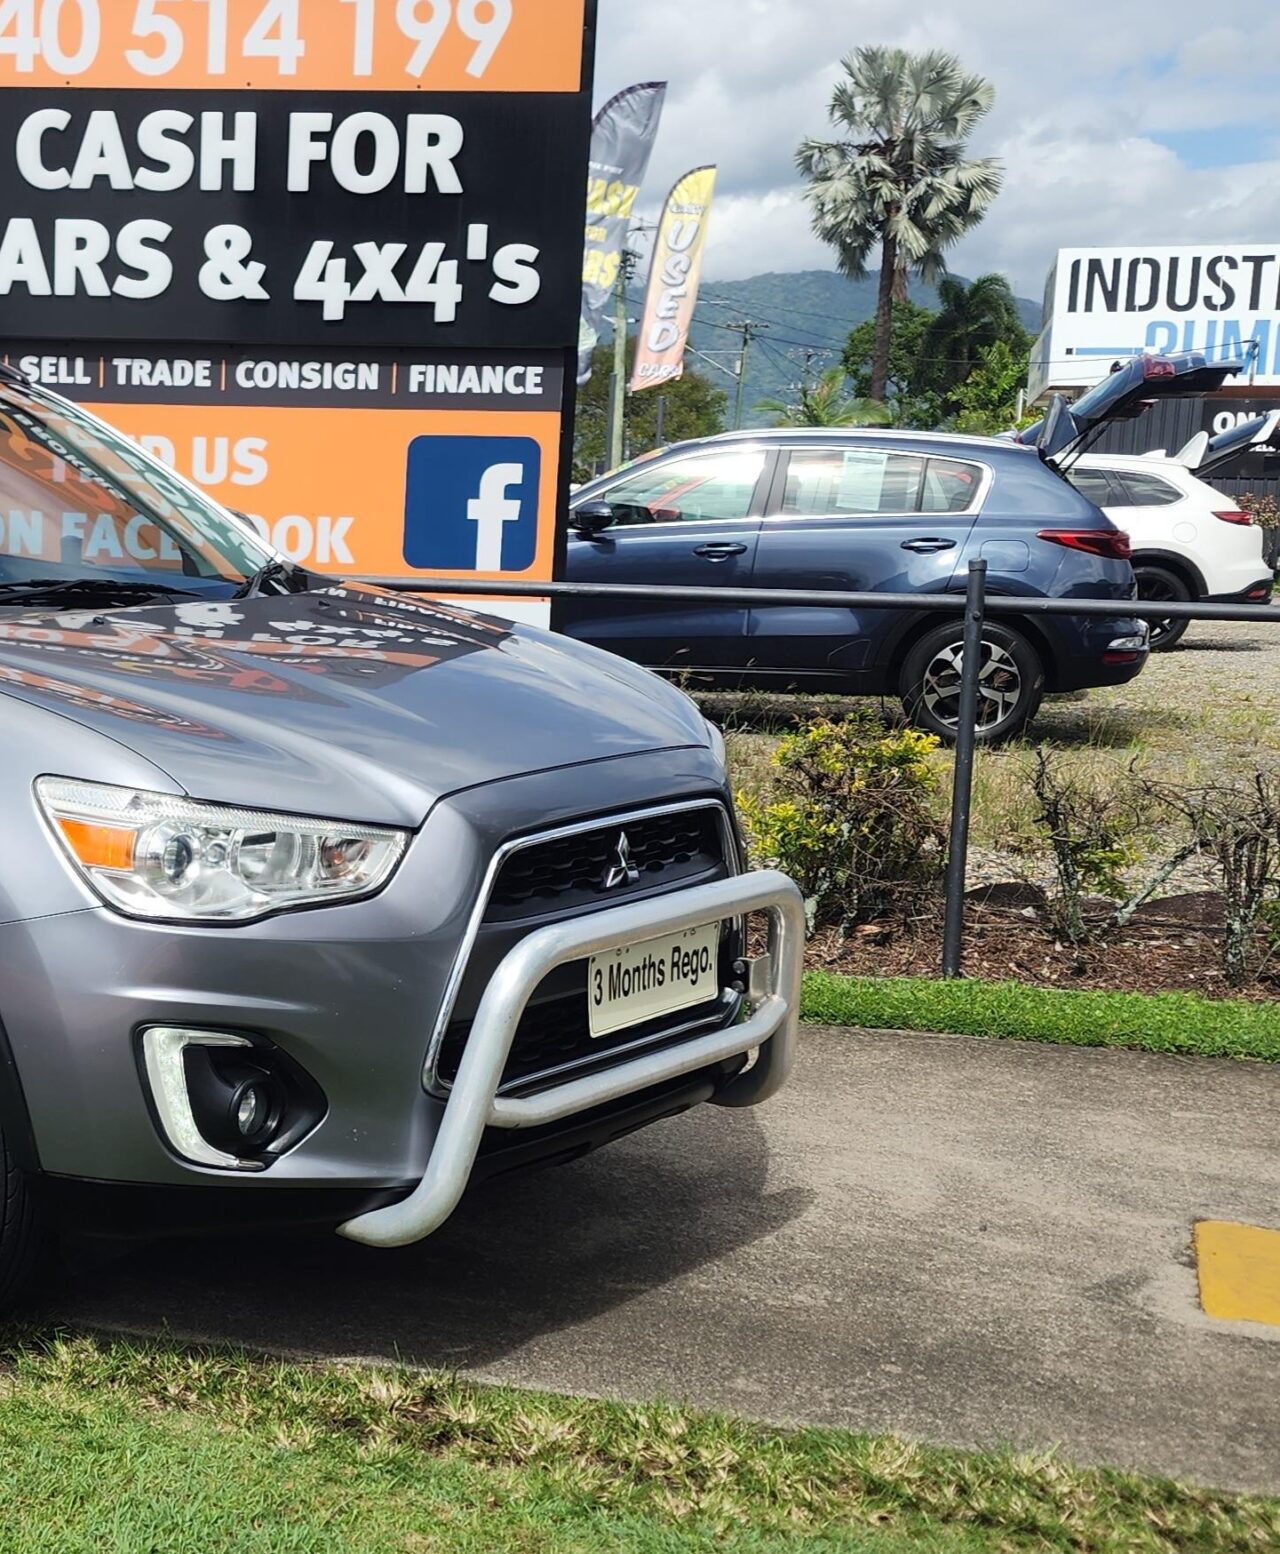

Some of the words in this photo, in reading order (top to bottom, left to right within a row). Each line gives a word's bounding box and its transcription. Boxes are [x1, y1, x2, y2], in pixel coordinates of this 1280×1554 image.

[124, 0, 306, 76] 514
[340, 0, 513, 79] 199
[15, 107, 257, 192] CASH
[287, 111, 464, 194] FOR
[198, 223, 270, 300] &
[647, 219, 700, 353] USED
[1067, 255, 1280, 313] INDUST
[20, 355, 91, 385] SELL
[113, 358, 211, 388] TRADE
[235, 361, 380, 392] CONSIGN
[408, 364, 544, 395] FINANCE
[1144, 319, 1280, 376] PUM
[192, 435, 269, 487] US
[60, 508, 355, 565] FACEOK
[594, 968, 603, 1006] 3
[608, 953, 665, 1002] Months
[670, 945, 713, 986] Rego.
